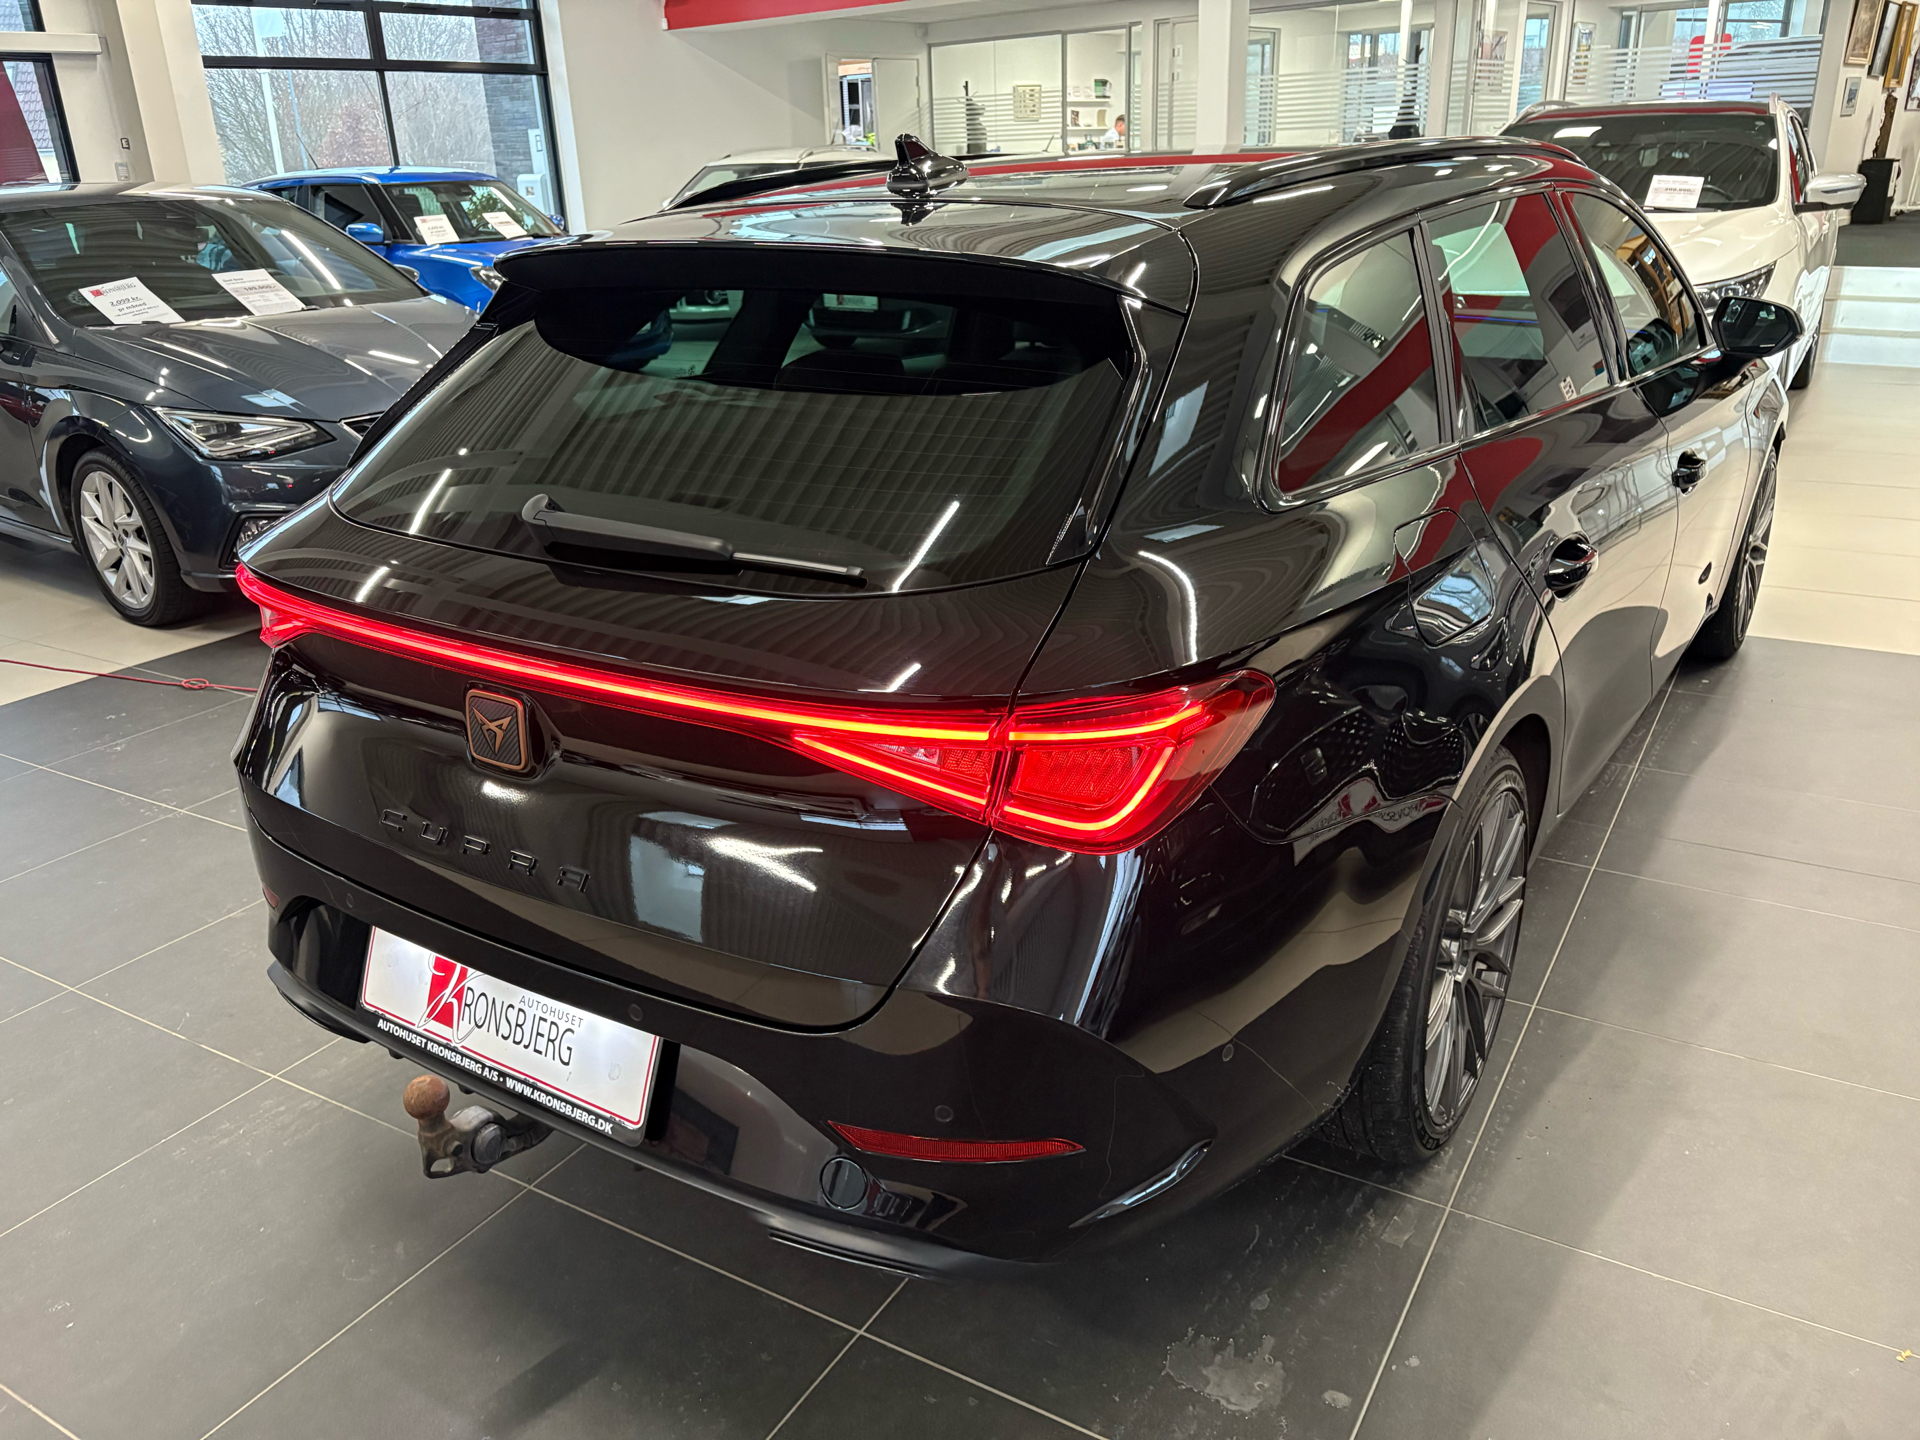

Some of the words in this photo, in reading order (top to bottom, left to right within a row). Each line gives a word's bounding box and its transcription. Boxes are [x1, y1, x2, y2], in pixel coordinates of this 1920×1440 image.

[379, 809, 592, 893] CUPRA
[417, 953, 575, 1067] KRONSBJERG
[519, 995, 584, 1028] AUTOHUSET
[377, 1018, 427, 1049] AUTOHUSET
[426, 1041, 483, 1075] KRONSBJERG
[482, 1067, 499, 1081] A/S
[505, 1076, 614, 1135] WWW.KRONSBJERG.DK
